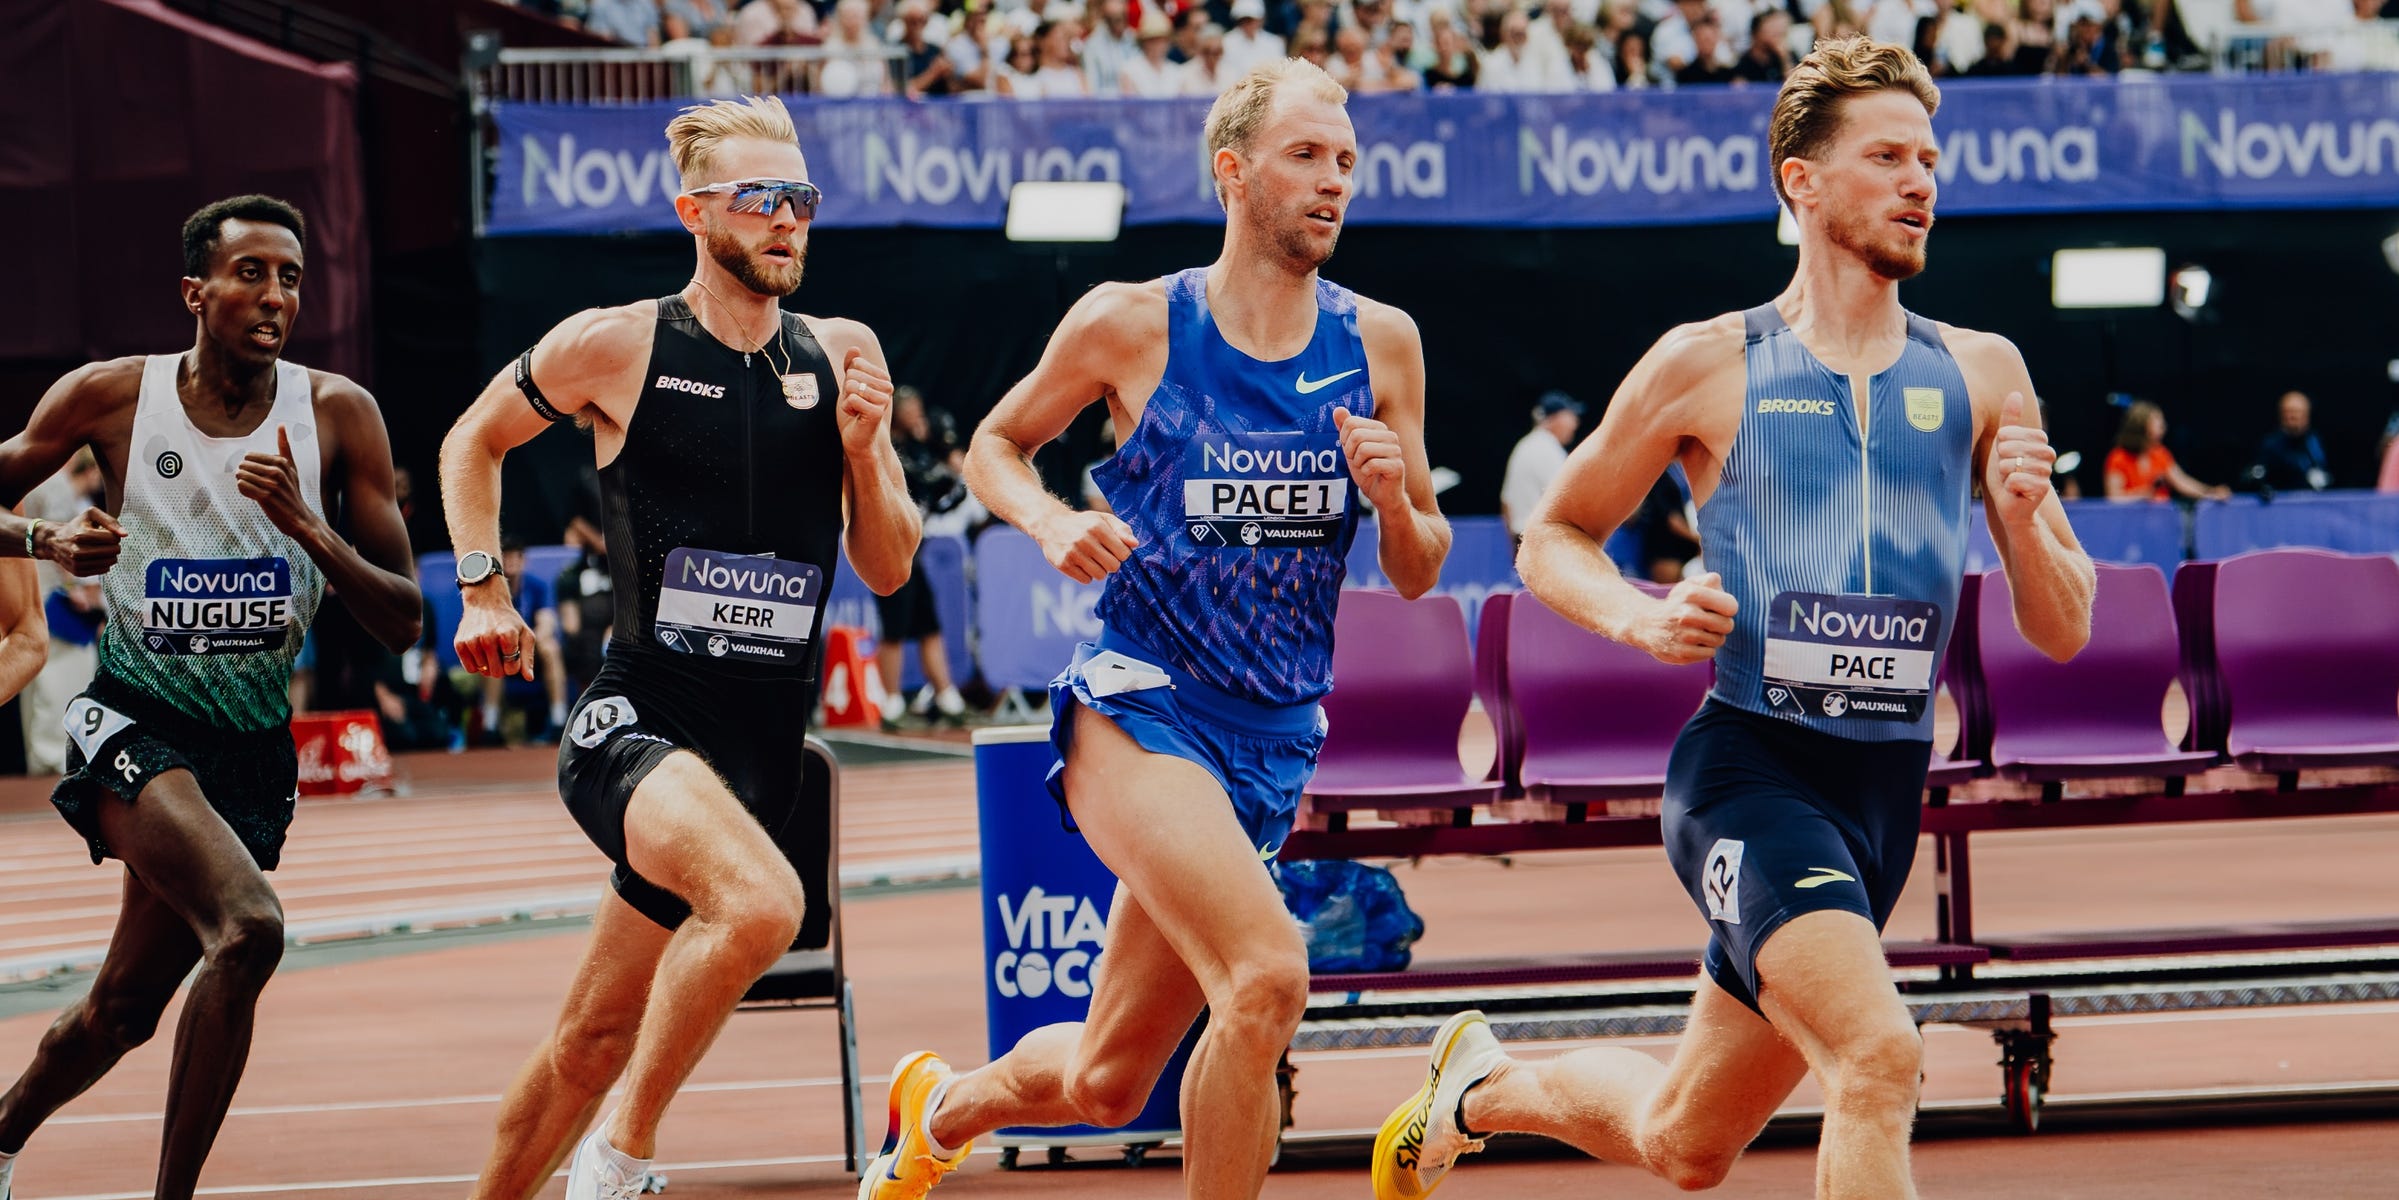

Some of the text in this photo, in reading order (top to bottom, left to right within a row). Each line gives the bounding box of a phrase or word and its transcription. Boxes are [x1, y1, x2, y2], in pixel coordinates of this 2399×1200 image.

[1934, 126, 2098, 184] vuna
[2181, 108, 2399, 179] Novun
[1518, 123, 1759, 195] Novuna
[655, 375, 726, 399] BROOKS
[1757, 398, 1836, 416] BROOKS
[1912, 413, 1940, 422] BEASTS
[1204, 442, 1336, 474] Novuna
[1212, 483, 1331, 515] PACE 1
[1264, 528, 1325, 538] VAUXHALL
[160, 566, 275, 593] Novuna
[682, 556, 806, 599] Novuna
[151, 600, 285, 628] NUGUSE
[712, 602, 774, 628] KERR
[1789, 600, 1928, 643] Novuna
[212, 637, 264, 647] VAUXHALL
[731, 643, 785, 657] VAUXHALL
[1830, 654, 1896, 680] PACE
[1850, 700, 1907, 713] VAUXHALL
[85, 707, 104, 737] 9
[582, 703, 618, 740] 10
[1709, 855, 1735, 911] 12
[998, 886, 1106, 949] VITA
